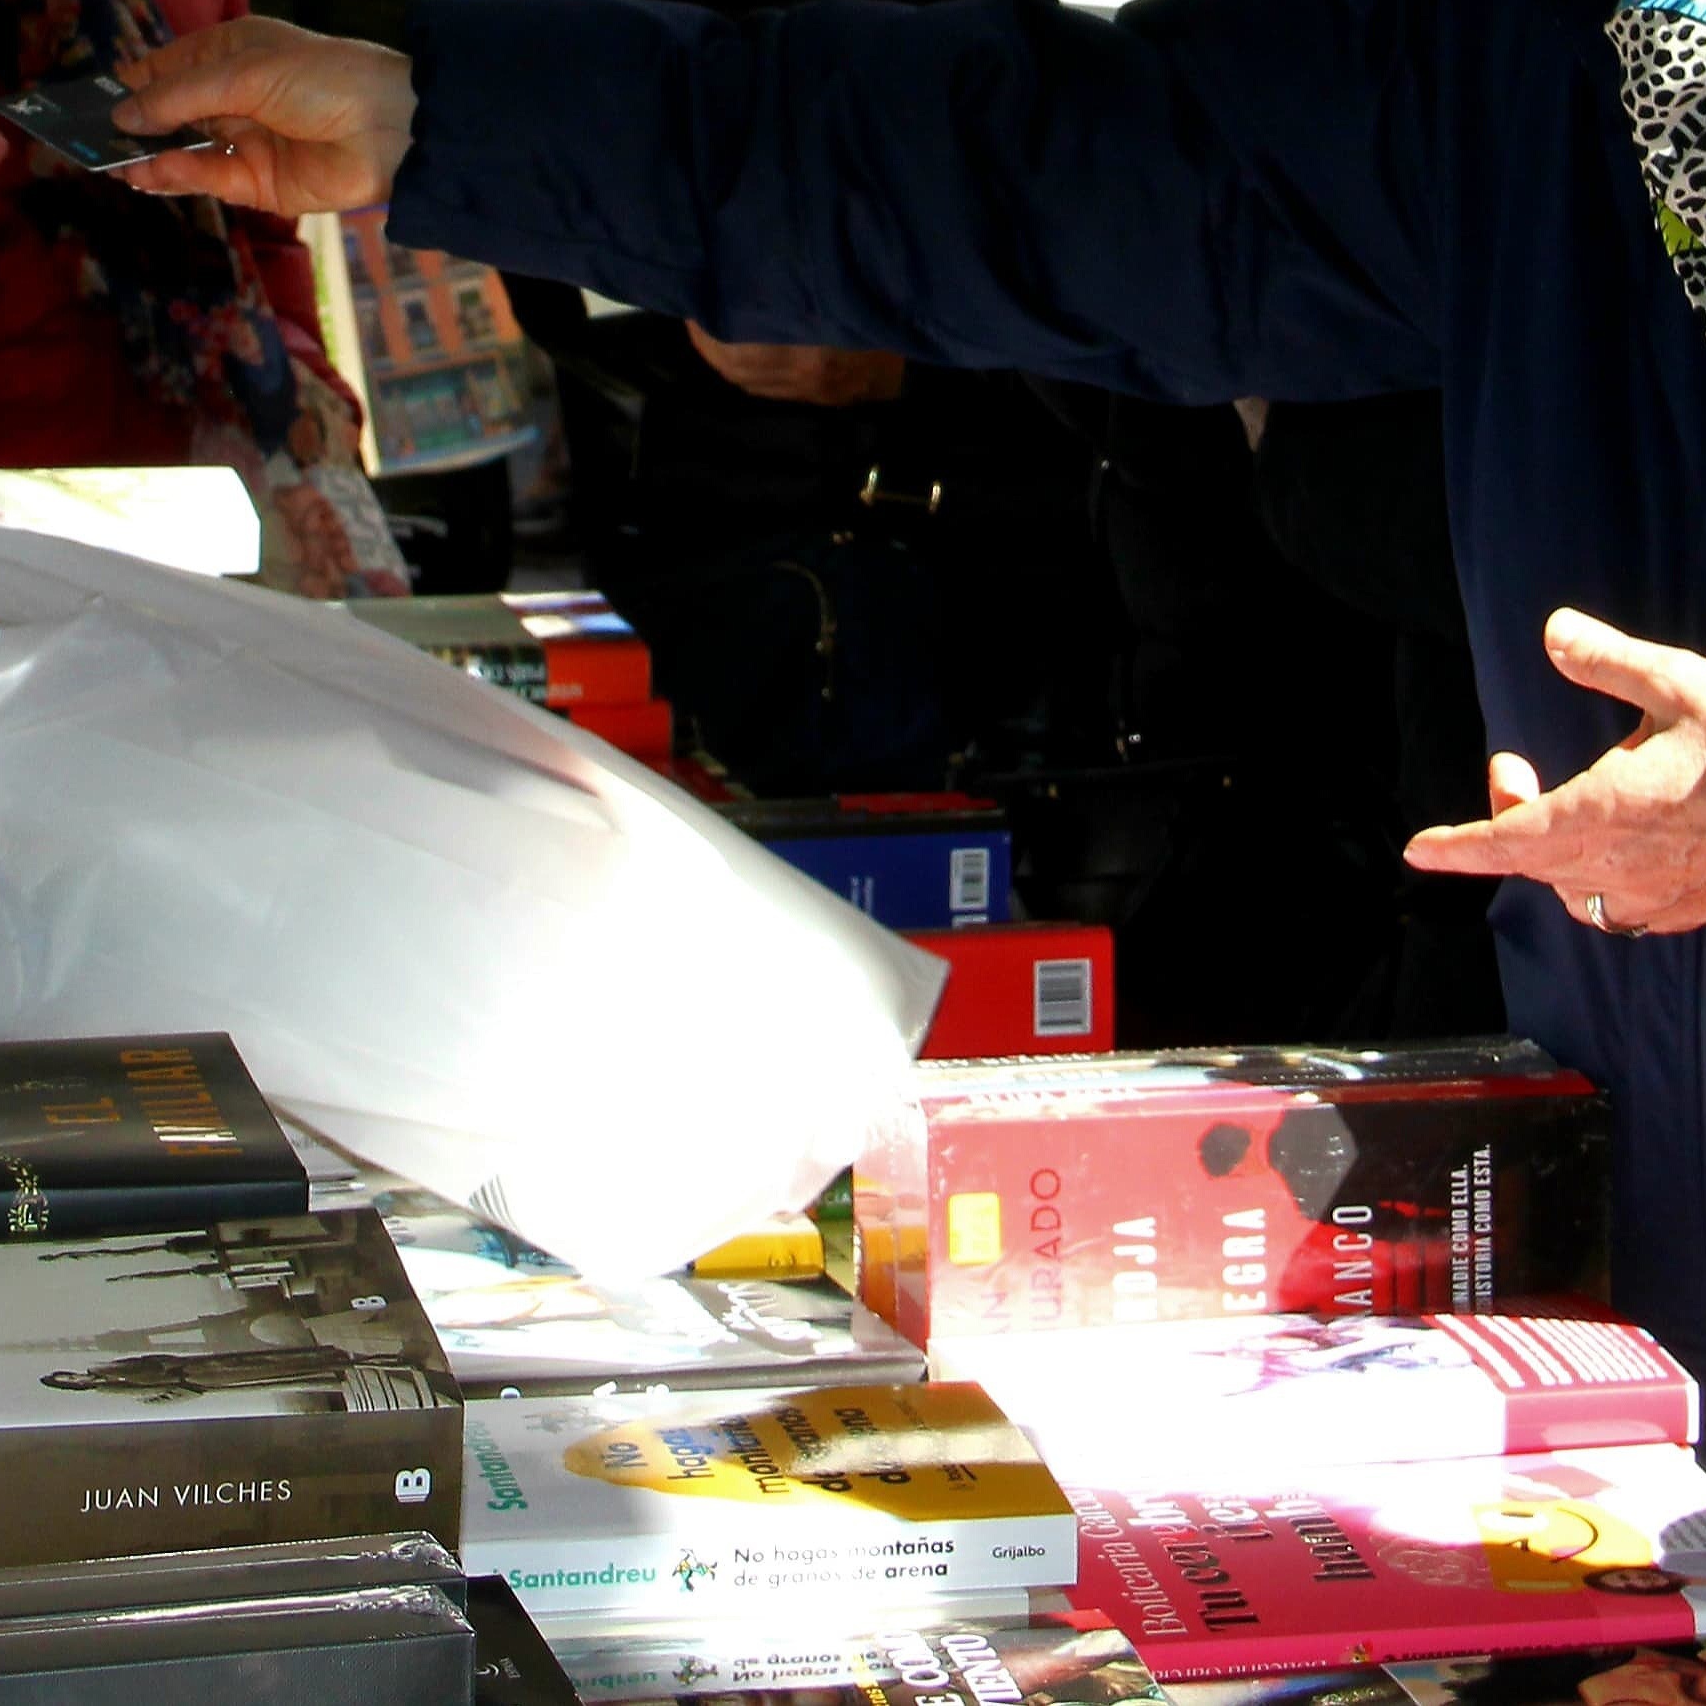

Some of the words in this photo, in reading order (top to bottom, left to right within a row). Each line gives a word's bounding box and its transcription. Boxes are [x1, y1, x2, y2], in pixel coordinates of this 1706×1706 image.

[1451, 1163, 1469, 1204] ELLA.
[1473, 1143, 1492, 1185] ESTA.
[1452, 1208, 1469, 1252] COMO
[1473, 1190, 1492, 1232] COMO
[1332, 1203, 1373, 1310] ANCO
[80, 1485, 160, 1514] JUAN
[173, 1478, 293, 1508] VILCHES
[733, 1548, 765, 1565] No
[884, 1562, 949, 1580] arena
[991, 1544, 1046, 1561] Grijalbo
[509, 1562, 657, 1591] Santandreu
[1097, 1541, 1189, 1637] Boticaria
[1197, 1588, 1261, 1632] Tu
